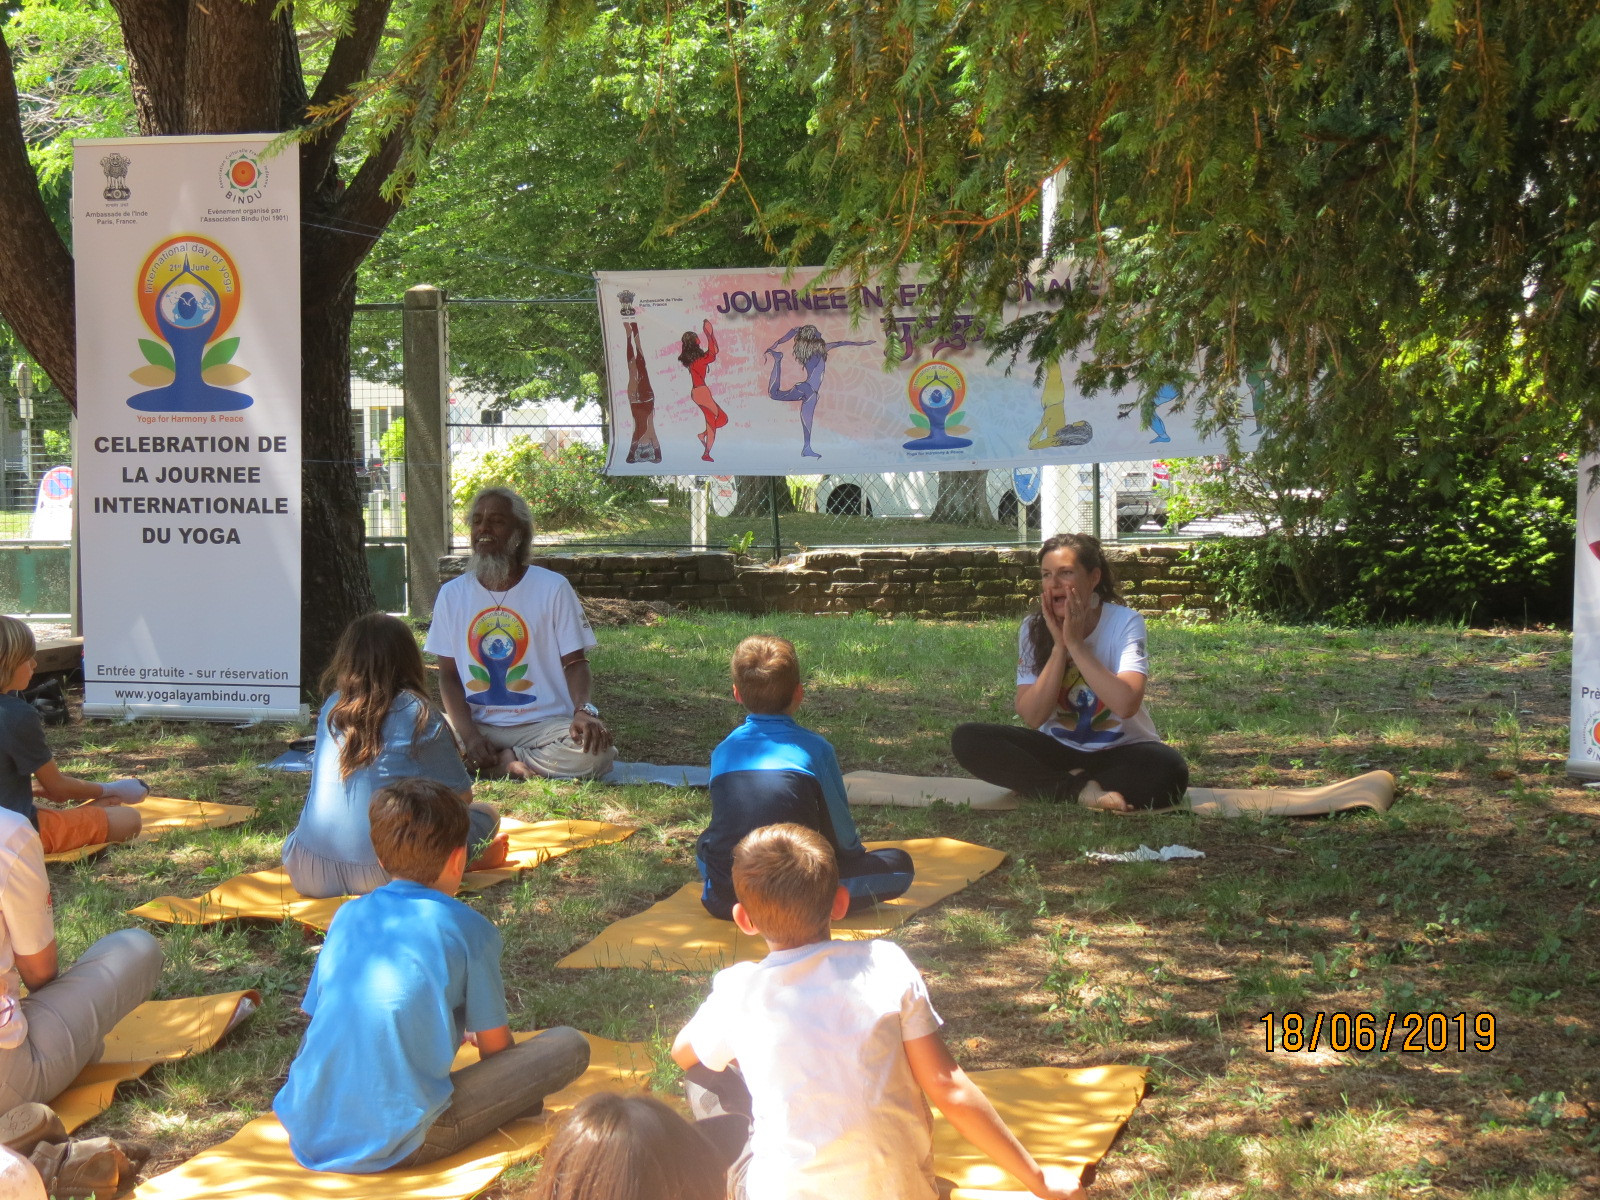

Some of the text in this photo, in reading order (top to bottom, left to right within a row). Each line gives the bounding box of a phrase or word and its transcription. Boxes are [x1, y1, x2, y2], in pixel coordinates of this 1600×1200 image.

[225, 190, 262, 204] BINDU
[243, 207, 270, 215] organisé
[96, 218, 115, 226] Paris,
[144, 243, 232, 294] International day of yoga
[191, 264, 210, 272] June
[716, 286, 849, 314] JOURNEE
[136, 414, 244, 425] Yoga for Harmony & Peace
[94, 436, 287, 453] CELEBRATION DE
[122, 466, 261, 483] LA JOURNEE
[94, 497, 289, 514] INTERNATIONALE
[142, 527, 241, 545] DU YOGA
[97, 664, 136, 677] Entrée
[139, 666, 185, 680] gratuite
[196, 669, 217, 679] sur
[219, 668, 289, 681] réservation
[115, 689, 271, 705] www.yogalayambindu.org
